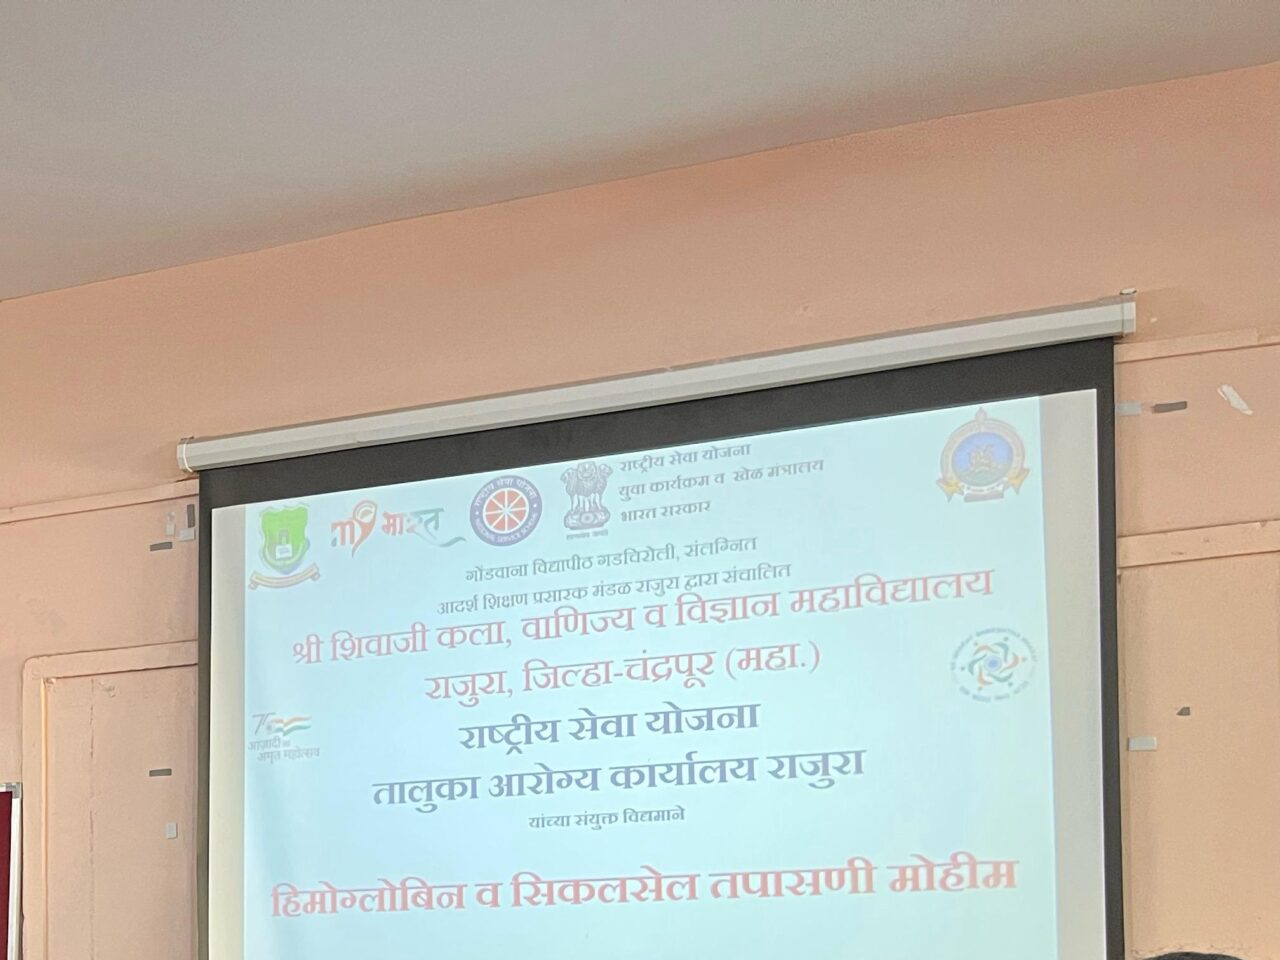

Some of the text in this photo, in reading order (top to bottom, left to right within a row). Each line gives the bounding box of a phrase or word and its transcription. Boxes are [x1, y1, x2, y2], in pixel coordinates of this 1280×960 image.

[619, 482, 645, 501] युवा
[650, 473, 710, 494] कार्यक्रम
[714, 473, 725, 486] व
[768, 459, 824, 480] मंत्रालय
[670, 447, 698, 466] सेवा
[702, 443, 751, 464] योजना
[621, 501, 711, 523] भारत सरकार
[437, 562, 792, 616] आदर्श शिक्षण प्रसारक मंडळ राजुरा द्वारा संचालित
[465, 563, 528, 584] गोंडवाना
[532, 554, 593, 576] विद्यापीठ
[292, 569, 996, 665] श्री शिवाजी कला, वाणिज्य व विज्ञान महाविद्यालय
[424, 640, 821, 708] राजुरा, जिल्हा-चंद्रपूर (महा.)
[458, 701, 762, 755] राष्ट्रीय सेवा योजना
[372, 749, 868, 814] तालुका आरोग्य कार्यालय राजुरा
[528, 805, 686, 831] यांच्या संयुक्त विद्यमाने
[271, 850, 1021, 918] हिमोग्लोबिन व सिकलसेल तपासणी मोहीम
